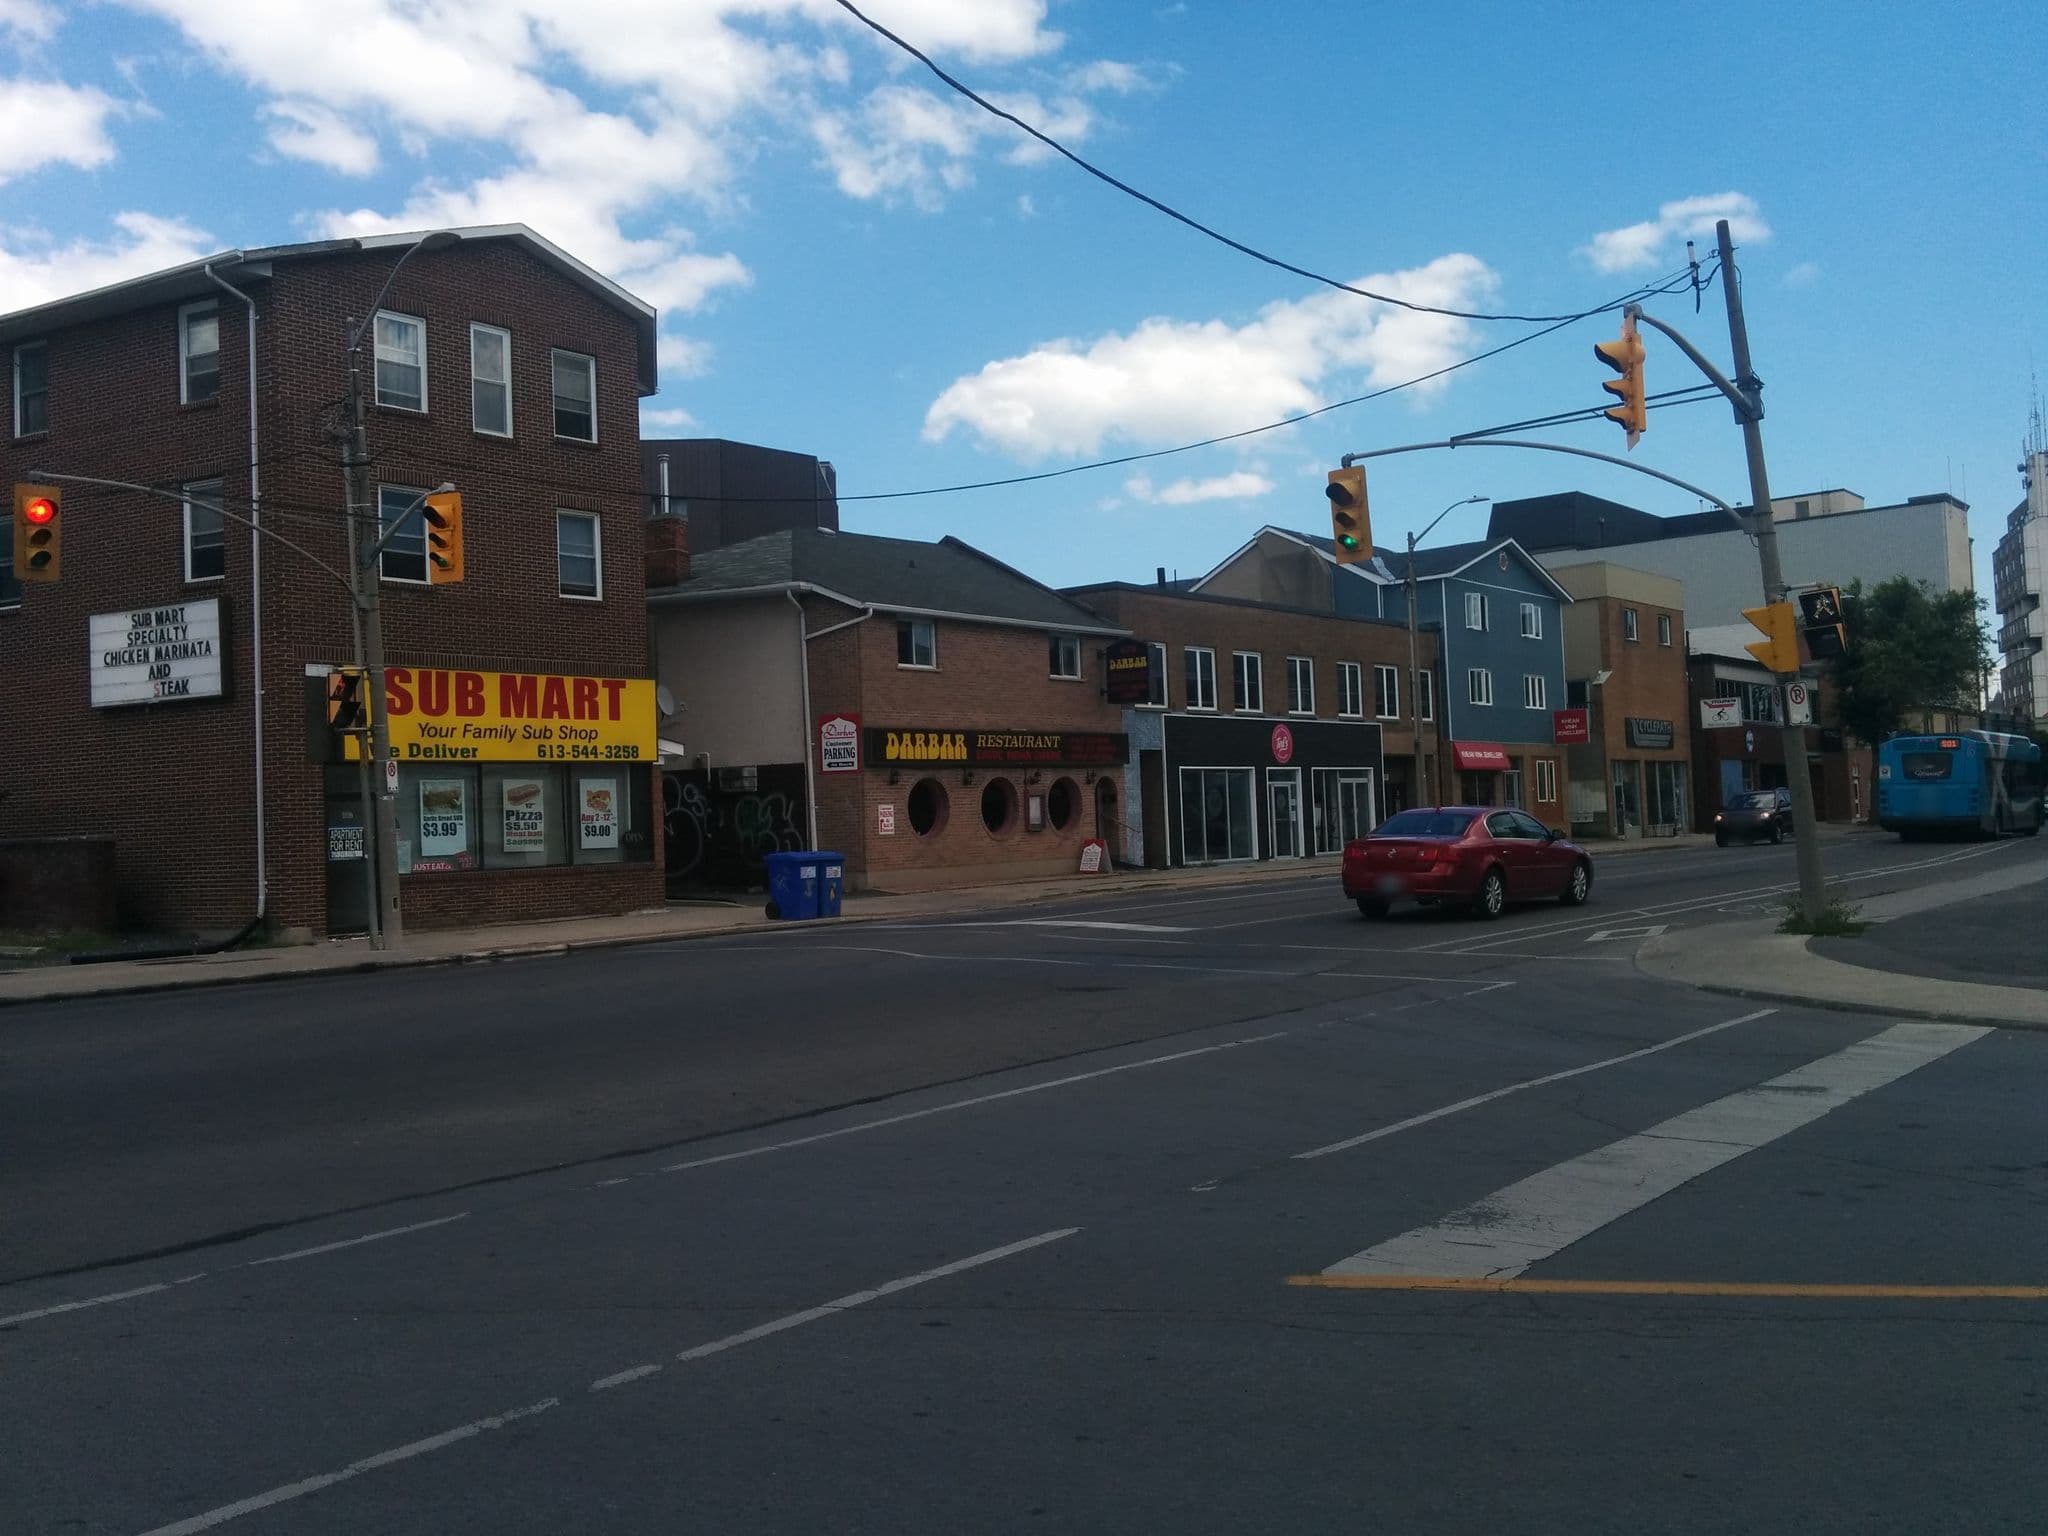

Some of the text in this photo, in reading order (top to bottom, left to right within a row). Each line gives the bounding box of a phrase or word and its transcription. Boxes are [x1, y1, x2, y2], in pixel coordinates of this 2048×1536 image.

[132, 608, 185, 628] SUB MART
[127, 626, 188, 647] SPECIALTY
[104, 641, 212, 666] CHICKEN MARINATA
[1109, 656, 1148, 670] DARBAR
[149, 664, 171, 680] AND
[154, 680, 190, 696] STEAK
[386, 668, 627, 721] SUB MART
[418, 722, 599, 744] Your Family Sub Shop
[408, 743, 479, 759] Deliver
[537, 744, 639, 759] 613-544-3258
[824, 747, 856, 759] PARKING
[885, 732, 969, 760] DARBAR
[976, 734, 1062, 748] RESTAURANT
[505, 810, 543, 821] Pizza
[581, 814, 594, 823] Any
[596, 813, 601, 822] 2
[423, 822, 458, 837] $3.99
[506, 822, 538, 831] $5.50
[585, 824, 611, 837] $9.00
[330, 829, 363, 840] APARTMENT
[330, 840, 363, 851] FOR RENT
[506, 838, 543, 846] Sausage
[413, 863, 429, 871] JUST
